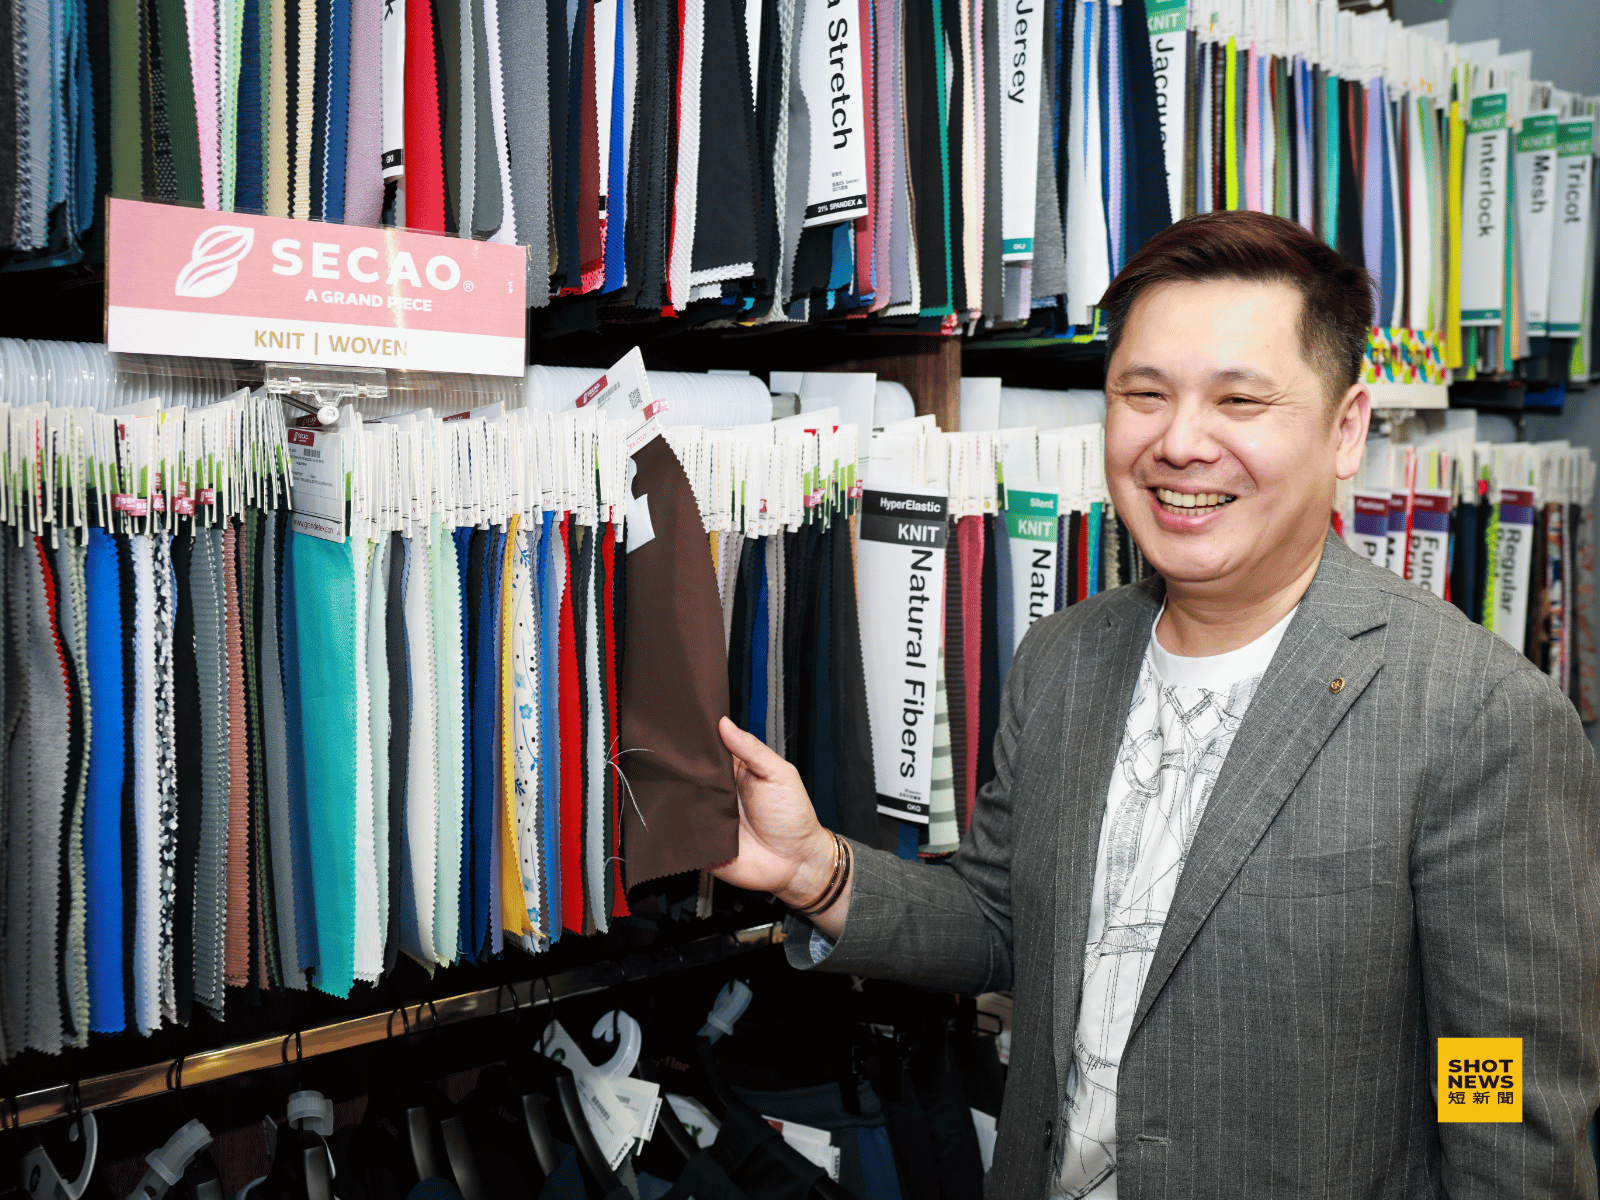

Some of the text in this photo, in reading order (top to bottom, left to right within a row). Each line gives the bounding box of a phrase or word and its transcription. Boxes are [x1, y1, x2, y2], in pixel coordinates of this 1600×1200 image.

[1147, 12, 1180, 31] KNIT
[1008, 0, 1033, 104] Jersey
[827, 18, 853, 150] Stretch
[817, 199, 856, 213] 21% SPANDEX
[1477, 134, 1498, 238] Interlock
[1530, 155, 1551, 214] Mesh
[1564, 160, 1587, 225] Tricot
[304, 288, 433, 312] A GRAND PIECE
[253, 329, 305, 350] KNIT
[328, 334, 408, 357] WOVEN
[880, 496, 941, 513] HyperElastic
[898, 523, 940, 543] KNIT
[1018, 519, 1053, 537] KNIT
[1029, 548, 1052, 626] Natu
[1420, 536, 1440, 592] Func
[1501, 528, 1521, 615] Regular
[905, 549, 933, 668] Natural
[900, 679, 925, 778] Fibers
